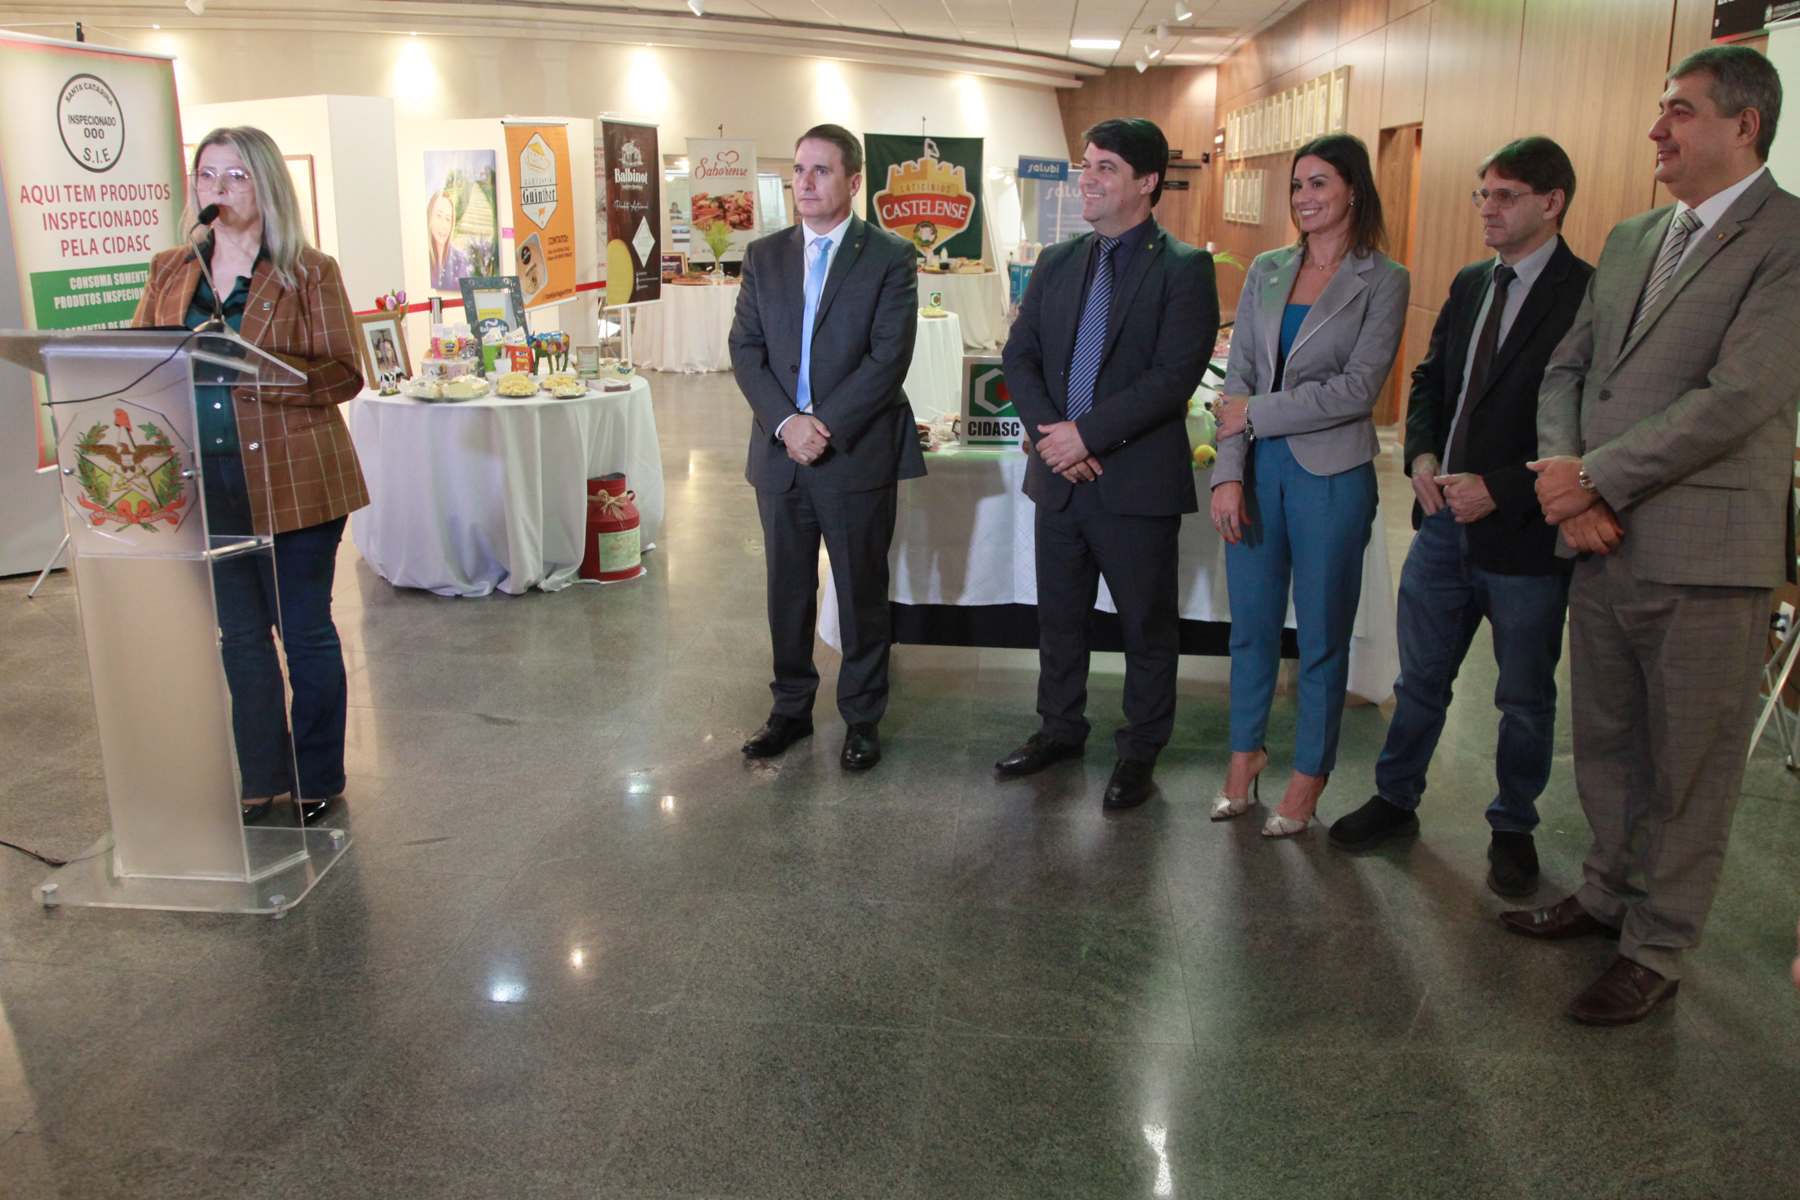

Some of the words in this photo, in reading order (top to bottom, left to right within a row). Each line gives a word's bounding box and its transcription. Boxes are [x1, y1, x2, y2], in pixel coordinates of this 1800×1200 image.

[65, 84, 84, 103] SANTA
[84, 82, 113, 107] CATARINA
[67, 114, 117, 127] INSPECIONADO
[614, 168, 649, 184] Balbinot
[694, 157, 748, 180] Saborense
[20, 184, 61, 206] AQUI
[64, 184, 96, 203] TEM
[100, 183, 171, 203] PRODUTOS
[900, 183, 951, 194] LATICÍNIOS
[42, 208, 159, 231] INSPECIONADOS
[882, 200, 968, 220] CASTELENSE
[61, 238, 99, 258] PELA
[103, 234, 152, 255] CIDASC
[69, 274, 113, 291] CONSUMA
[54, 292, 101, 310] PRODUTOS
[102, 287, 145, 304] INSPECION
[967, 421, 1020, 437] CIDASC
